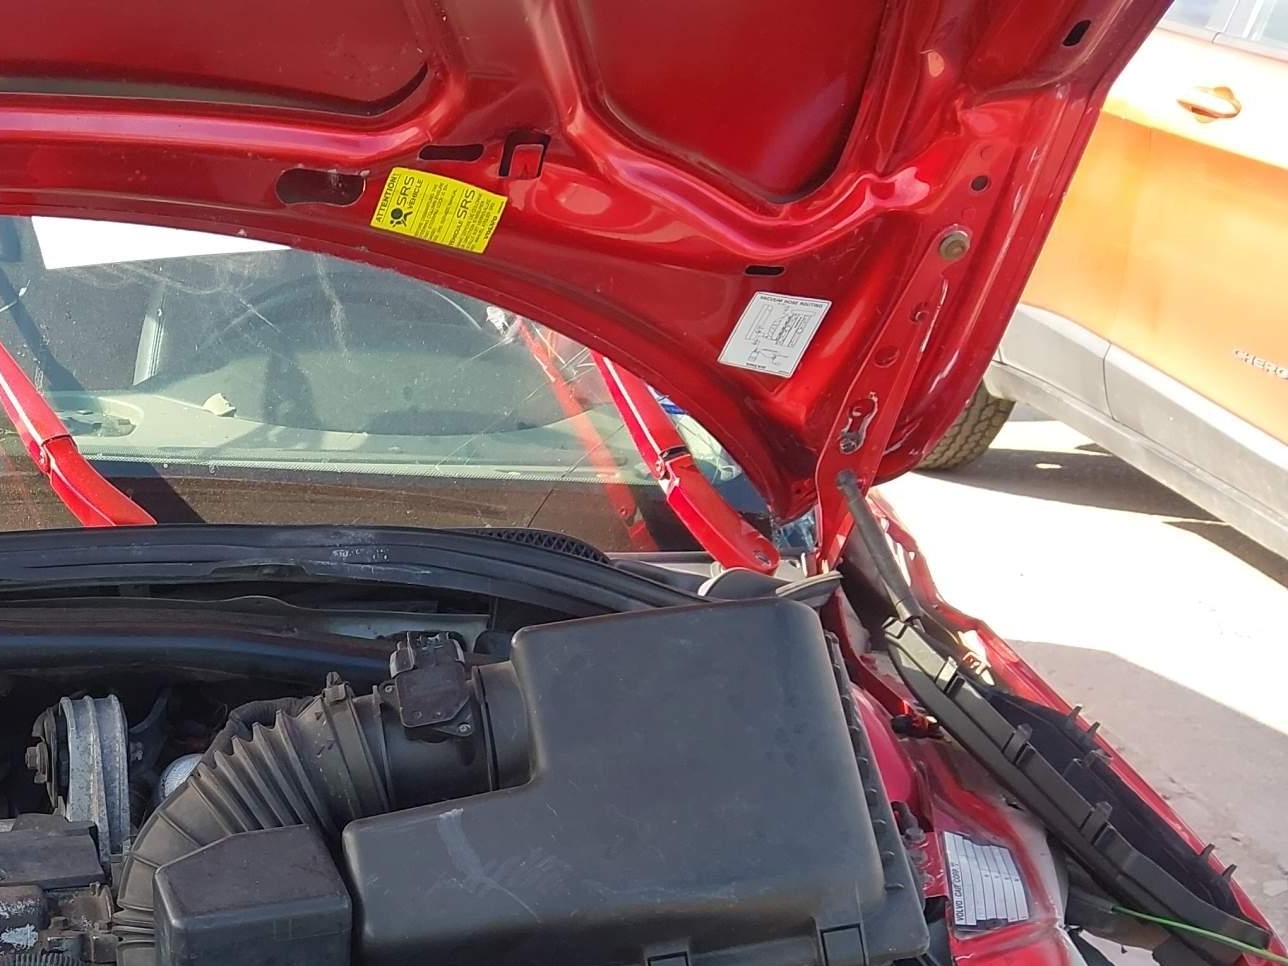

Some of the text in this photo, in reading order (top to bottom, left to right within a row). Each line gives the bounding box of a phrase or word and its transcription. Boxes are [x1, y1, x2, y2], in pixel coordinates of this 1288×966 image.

[397, 176, 415, 207] SRS
[407, 179, 424, 209] VEHICLE
[457, 189, 476, 219] SRS
[955, 899, 964, 922] VOLVO
